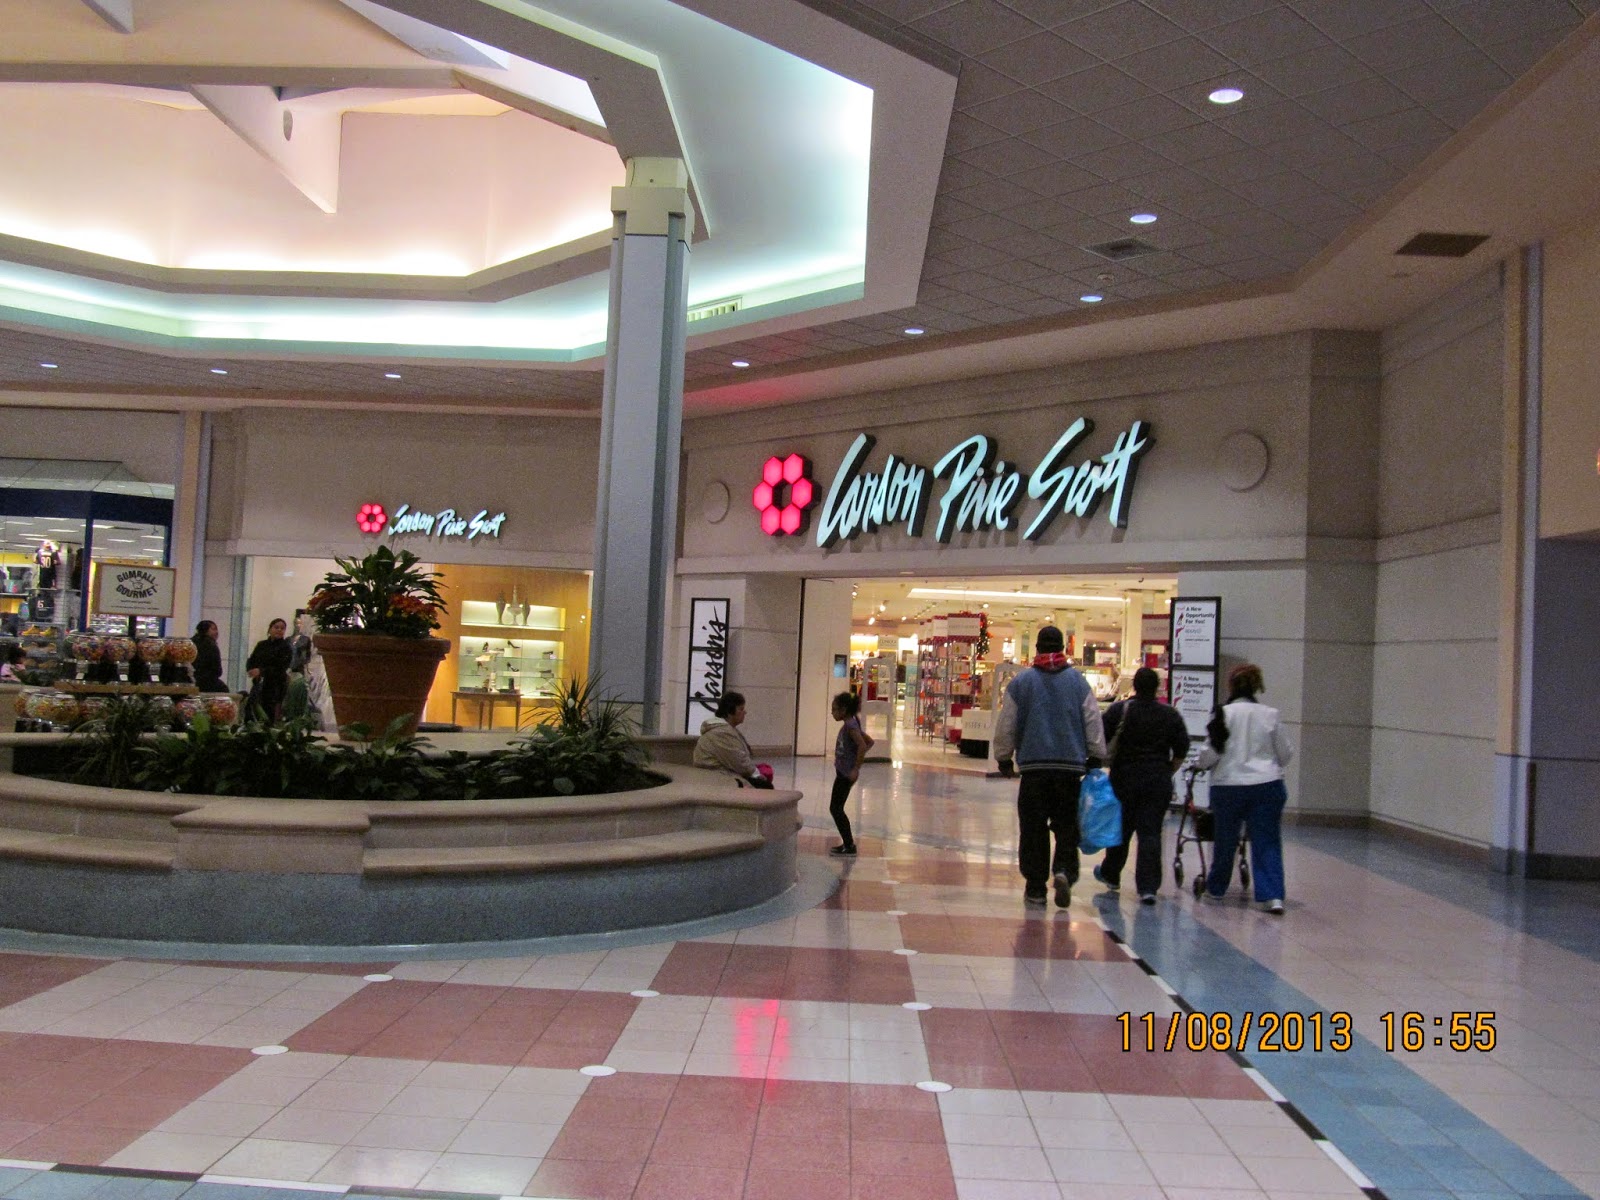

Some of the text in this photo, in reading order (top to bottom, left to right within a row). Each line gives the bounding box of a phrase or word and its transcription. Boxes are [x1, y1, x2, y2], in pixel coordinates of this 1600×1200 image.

[816, 416, 1147, 548] Carson Pirie Scott
[388, 504, 506, 540] Carson Pirie Scott
[116, 570, 156, 585] GUMBALL
[116, 584, 158, 598] GOURMET
